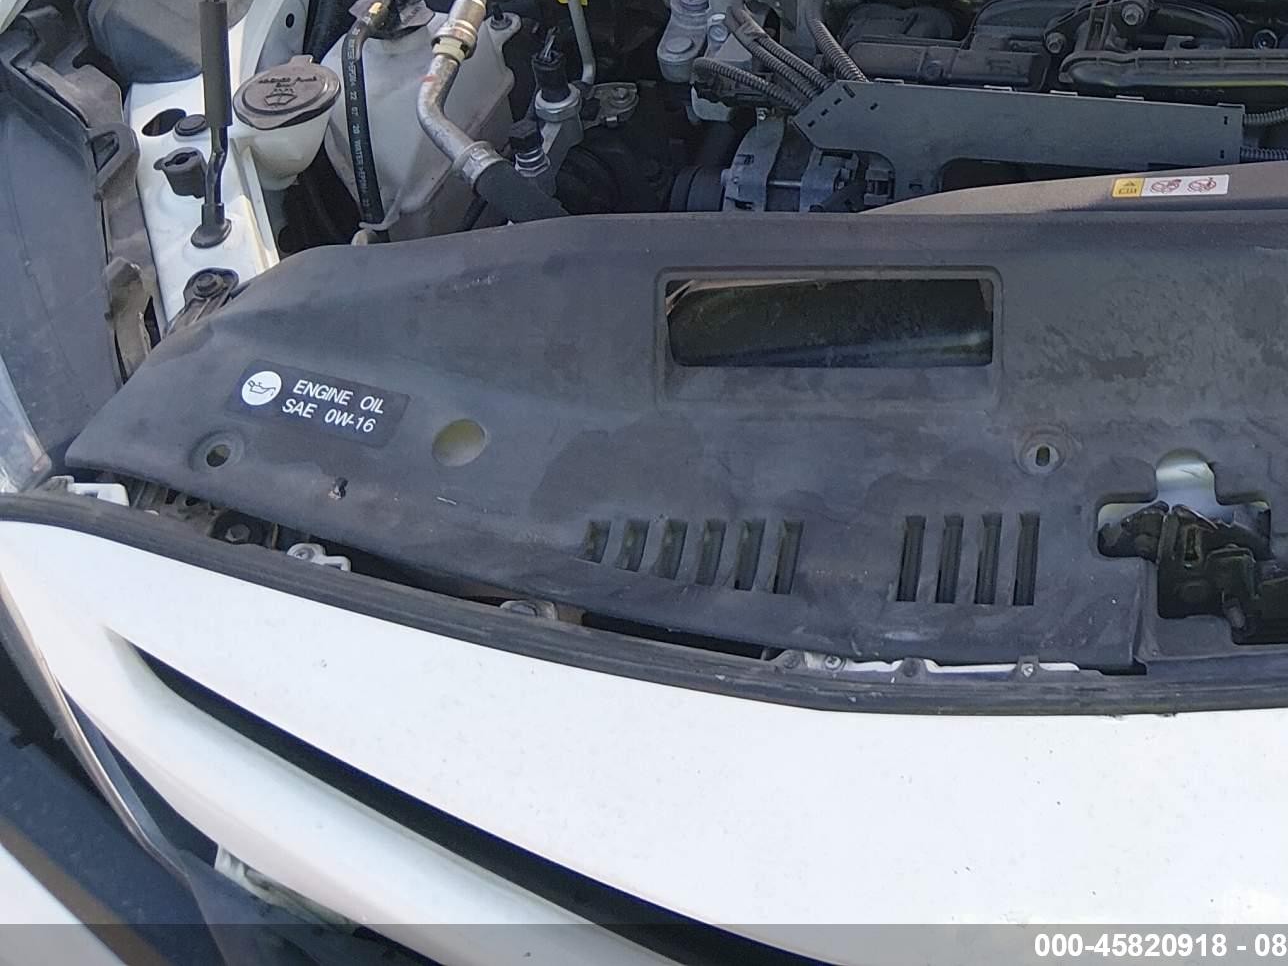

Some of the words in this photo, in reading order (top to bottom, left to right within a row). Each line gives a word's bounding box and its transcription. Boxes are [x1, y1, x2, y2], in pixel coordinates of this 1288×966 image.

[292, 379, 354, 406] ENGINE
[360, 395, 384, 414] OIL
[282, 398, 318, 419] SAE
[324, 408, 376, 433] 0W-16
